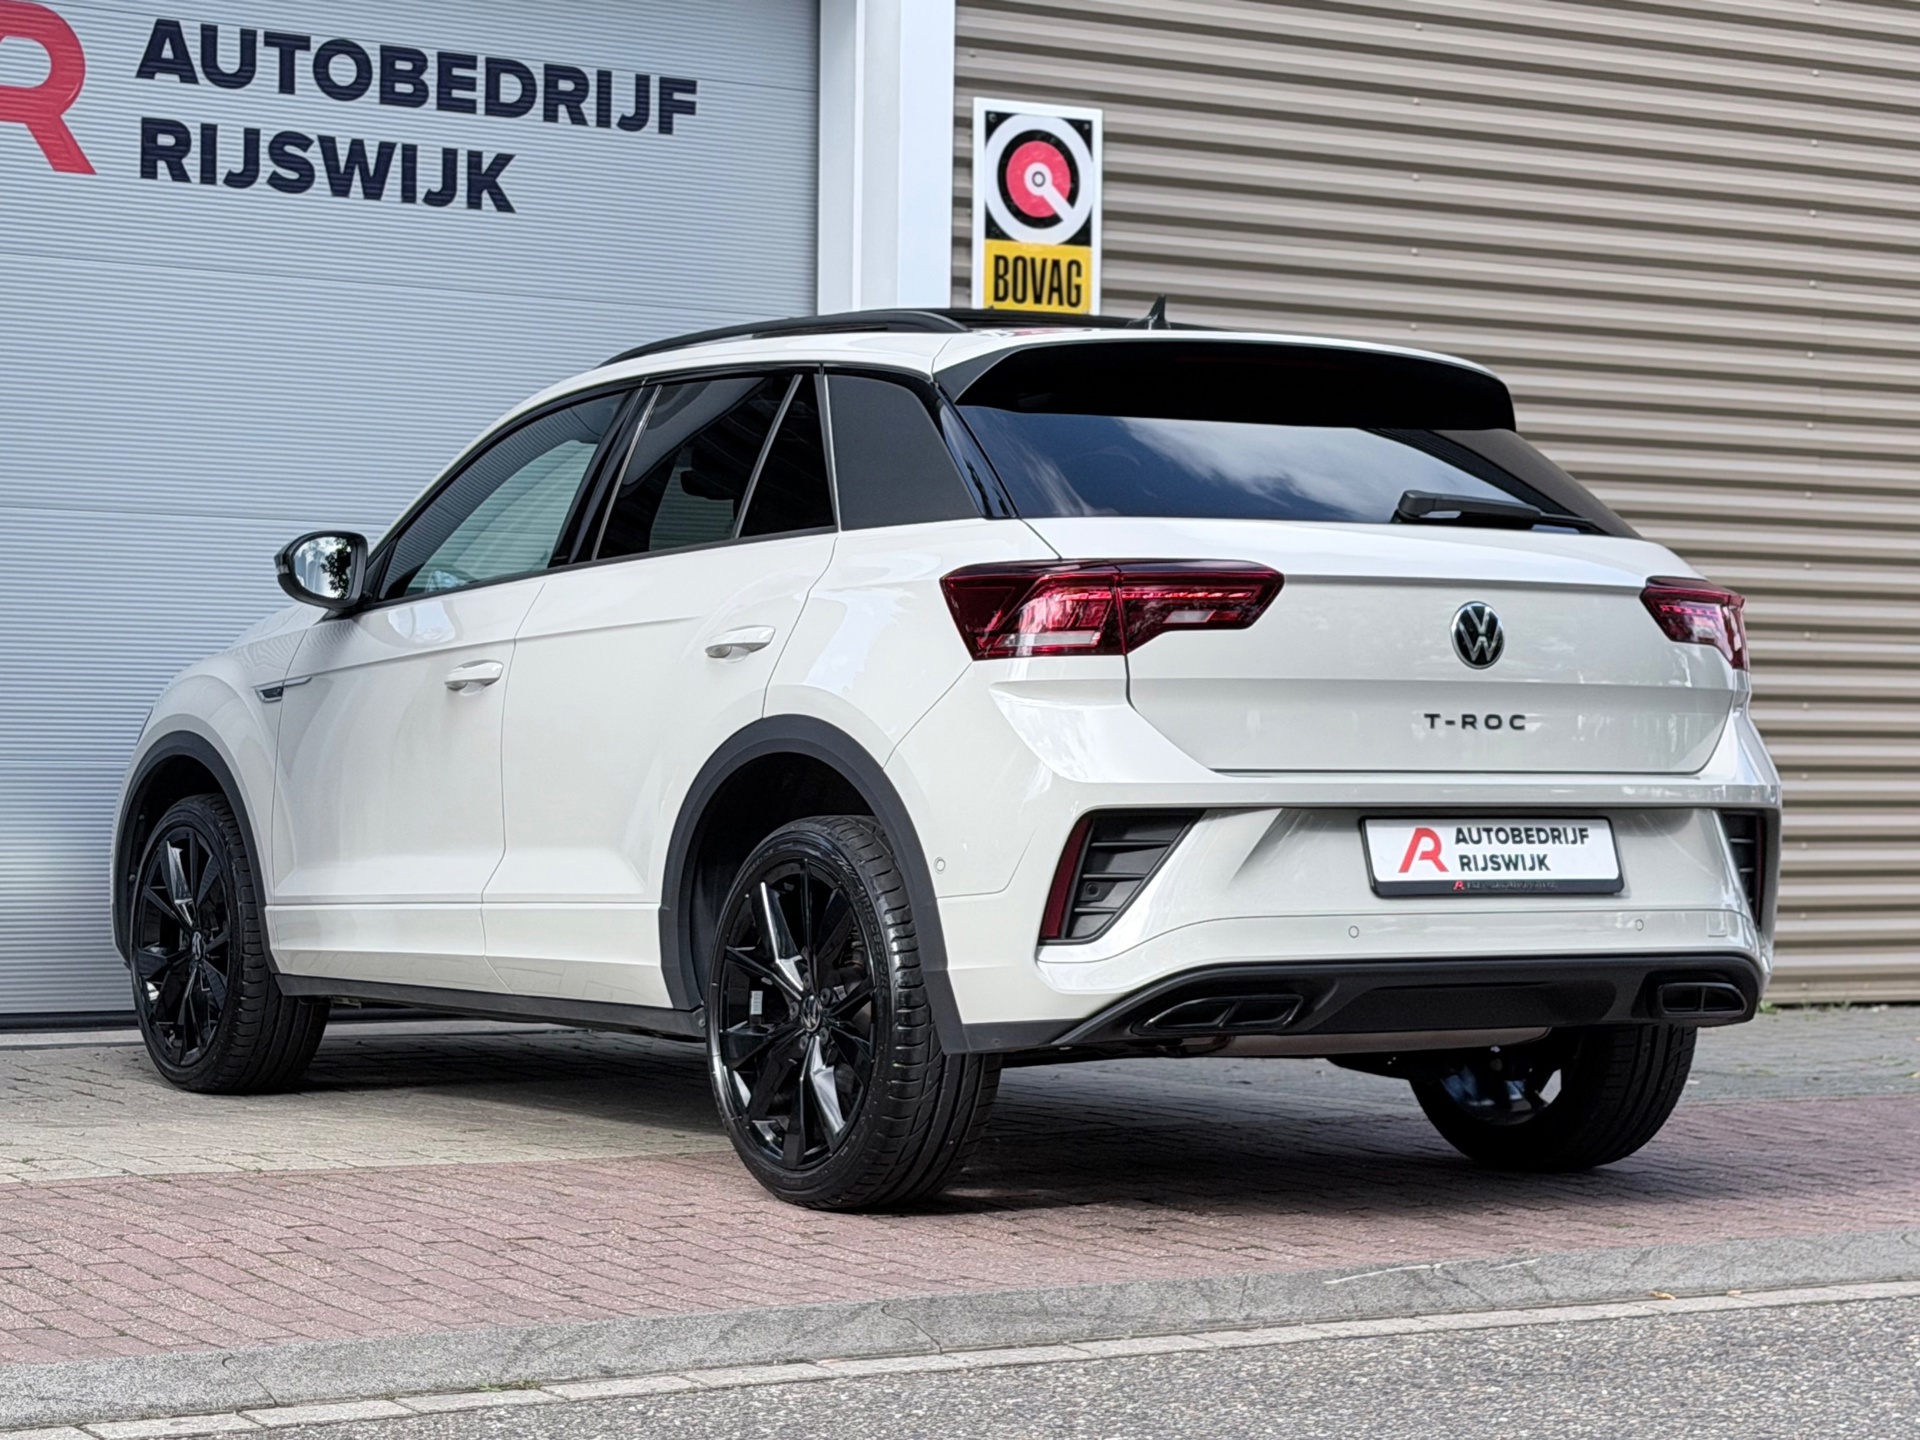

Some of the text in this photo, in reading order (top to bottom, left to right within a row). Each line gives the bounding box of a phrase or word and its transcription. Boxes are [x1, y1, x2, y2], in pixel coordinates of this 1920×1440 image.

[135, 17, 699, 136] AUTOBEDRIJF
[139, 116, 518, 214] RIJSWIJK
[993, 253, 1083, 309] BOVAG
[1423, 712, 1527, 731] T-ROC
[1454, 826, 1590, 846] AUTOBEDRIJF
[1458, 853, 1552, 873] RIJSWIJK
